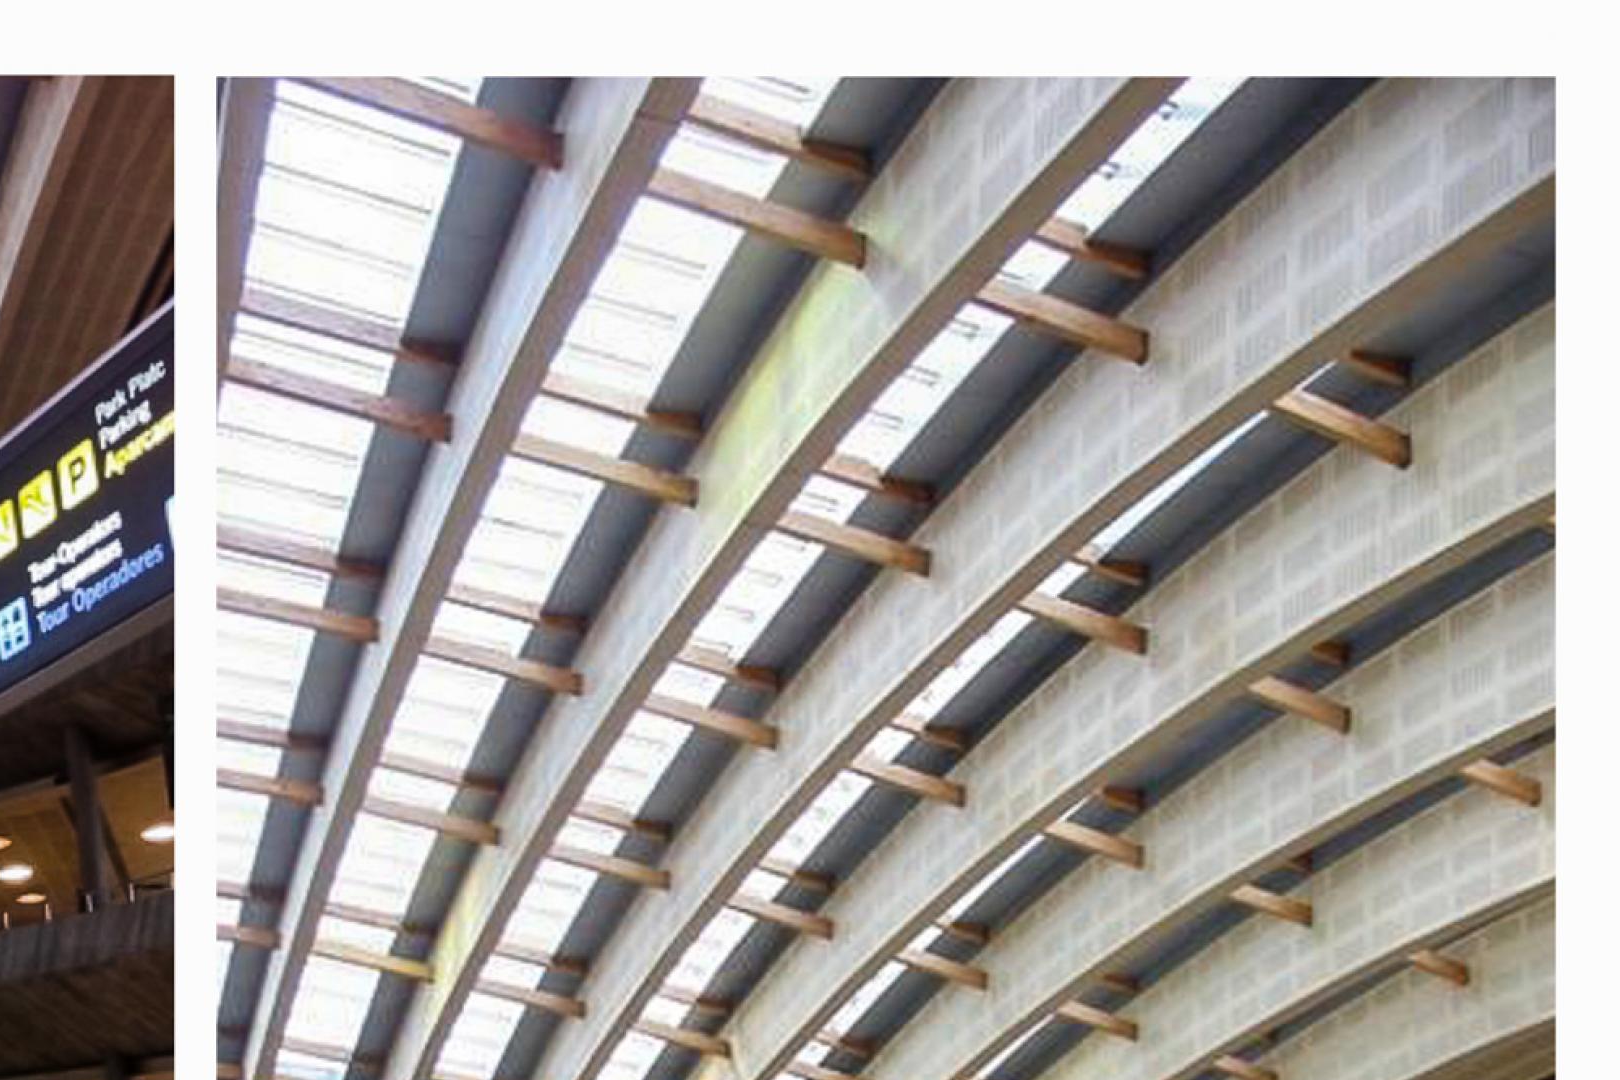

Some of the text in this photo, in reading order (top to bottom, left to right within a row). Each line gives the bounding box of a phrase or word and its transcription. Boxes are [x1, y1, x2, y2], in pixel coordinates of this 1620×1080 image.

[95, 389, 127, 426] Park
[98, 399, 152, 450] Parking
[31, 579, 61, 609] Tour
[36, 543, 164, 633] Tour Operadores
